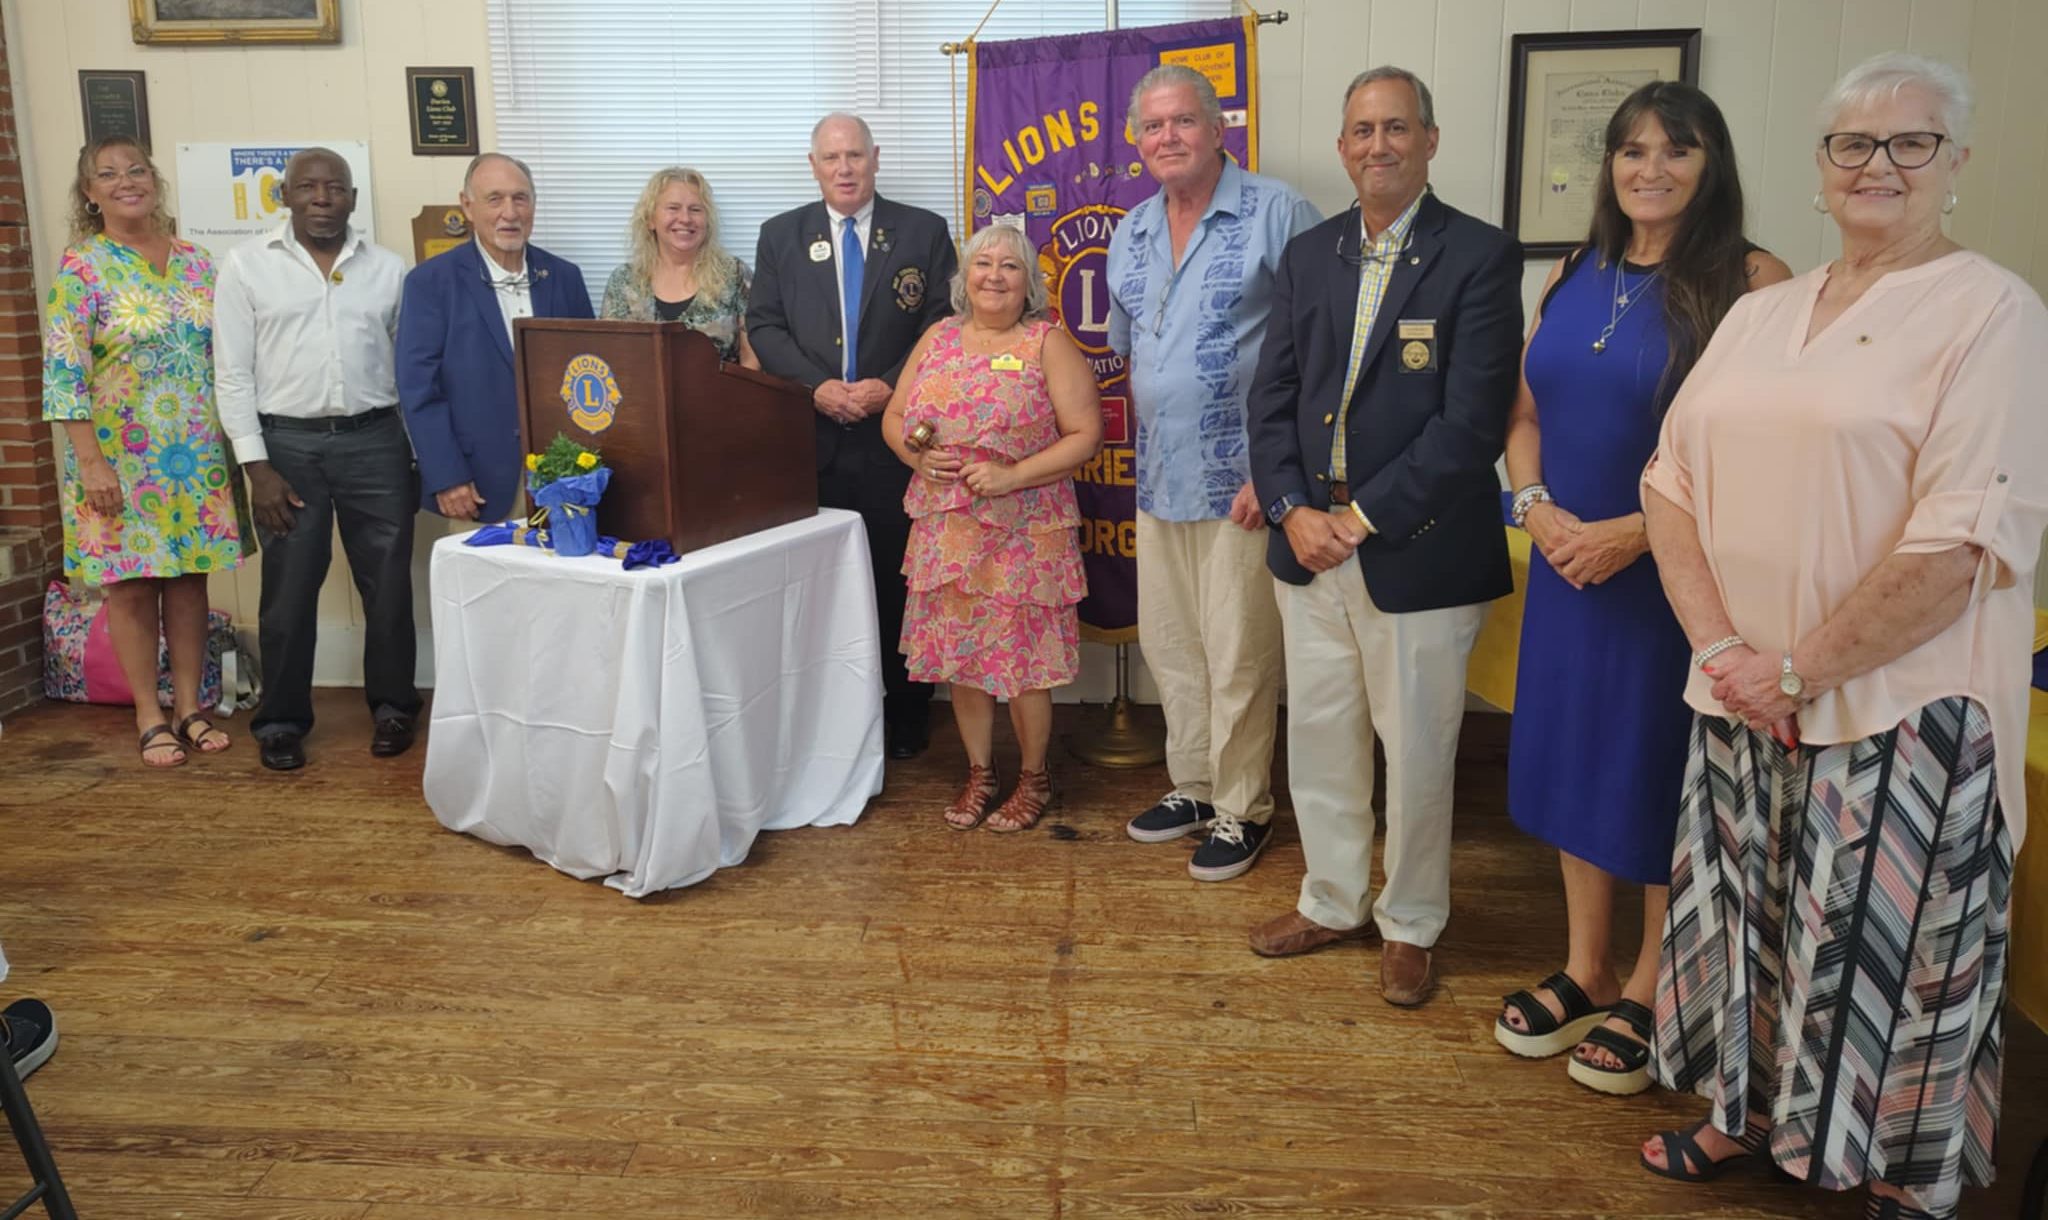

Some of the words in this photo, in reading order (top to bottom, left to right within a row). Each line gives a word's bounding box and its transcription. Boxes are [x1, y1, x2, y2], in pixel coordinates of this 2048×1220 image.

[1194, 53, 1211, 61] CLUB
[977, 101, 1100, 196] LIONS
[235, 157, 273, 165] THERE'S
[275, 157, 283, 165] A
[189, 228, 205, 236] The
[207, 228, 252, 236] Association
[1059, 215, 1121, 250] LION
[1078, 269, 1111, 332] L
[570, 357, 609, 378] LIONS
[583, 379, 600, 407] L
